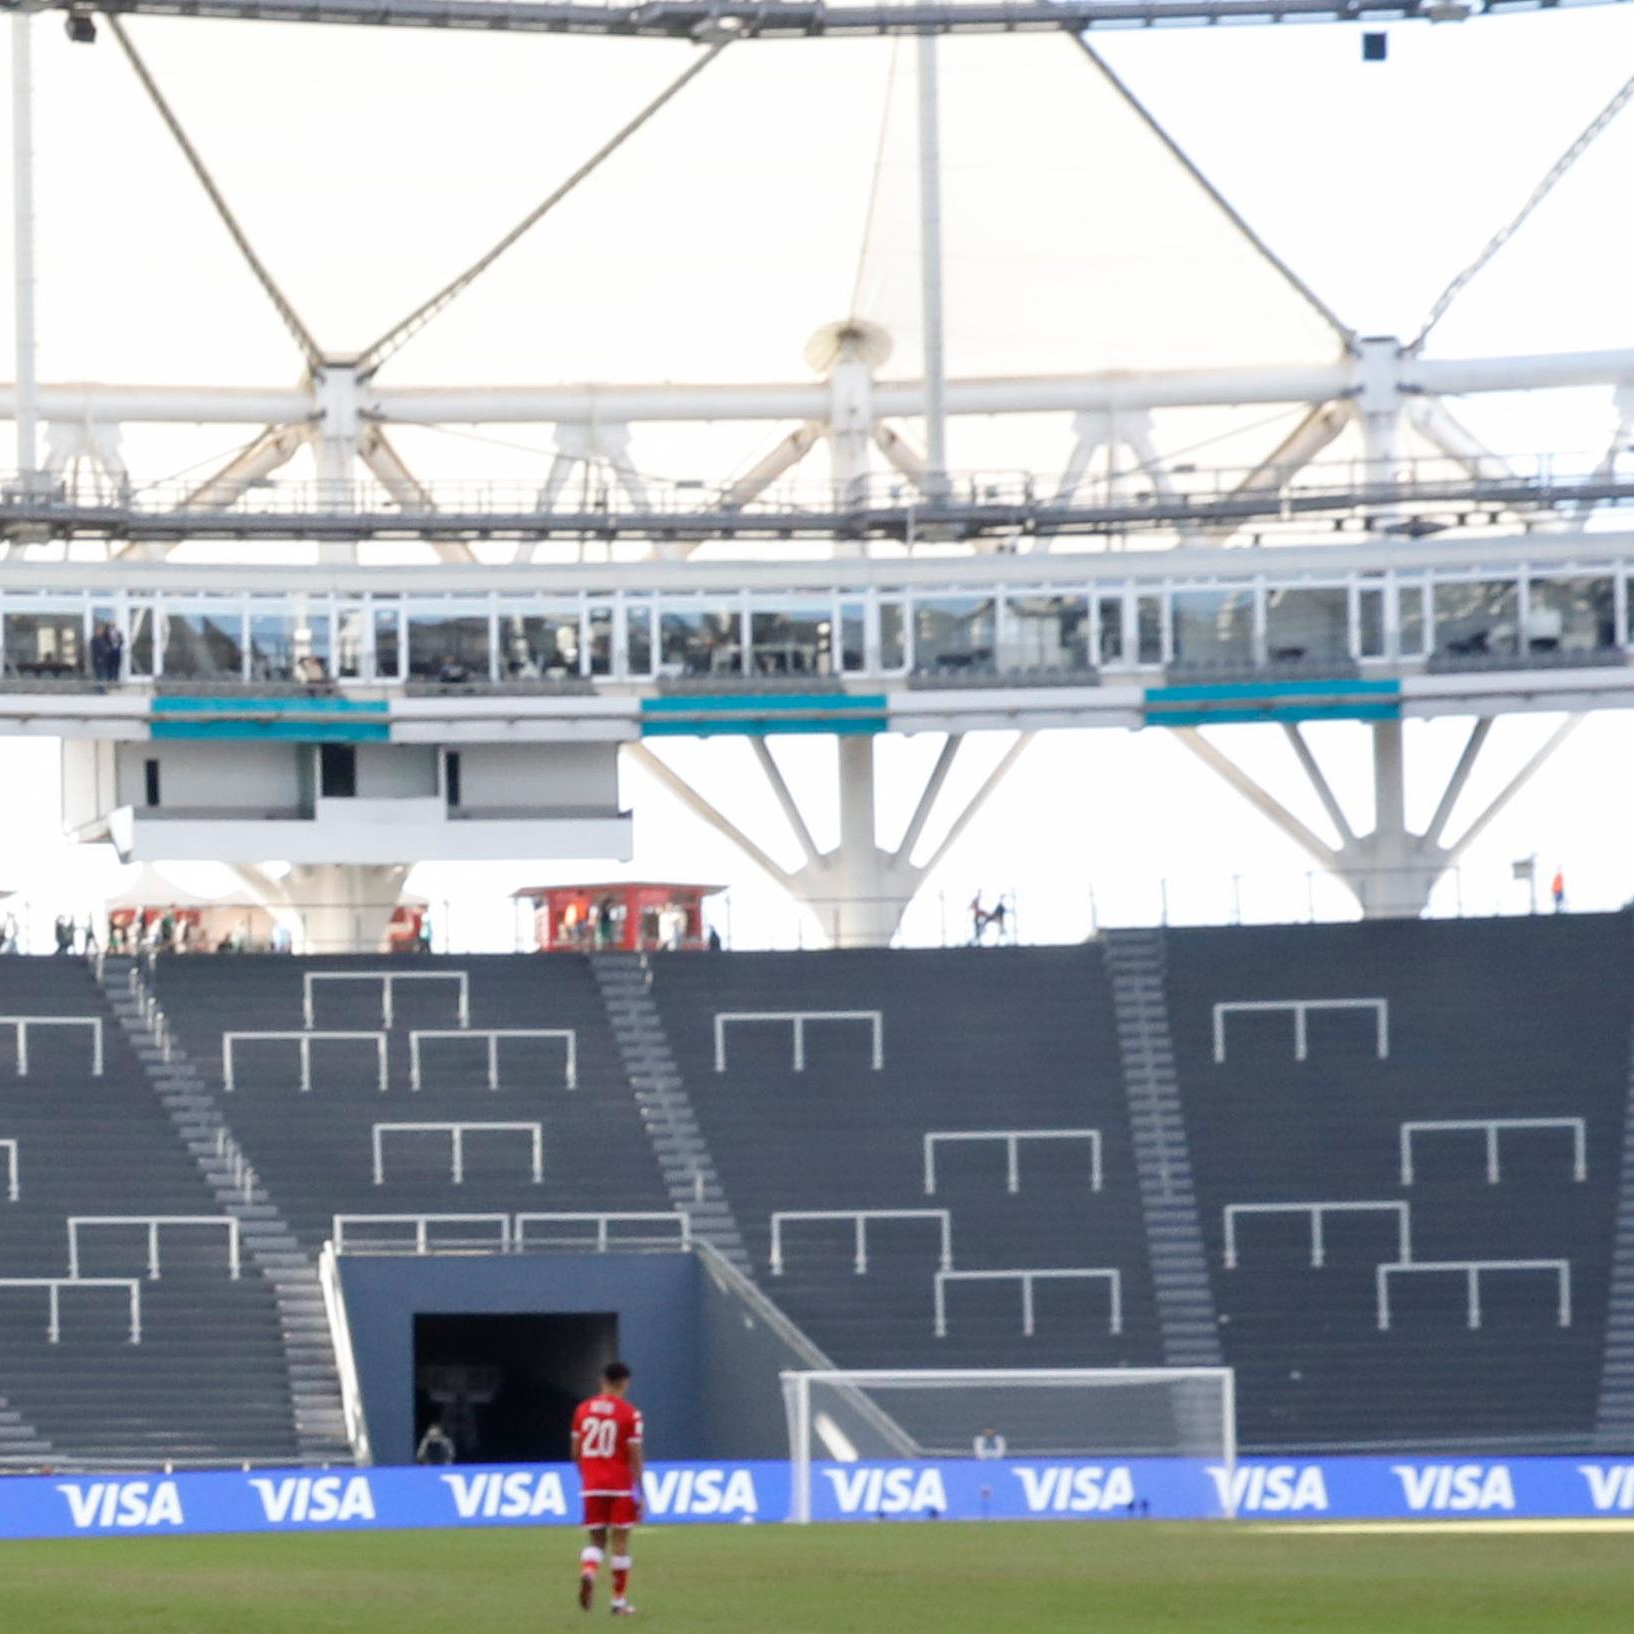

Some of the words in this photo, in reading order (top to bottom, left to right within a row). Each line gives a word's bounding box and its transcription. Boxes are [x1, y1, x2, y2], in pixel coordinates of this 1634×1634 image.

[580, 1416, 618, 1458] 20
[56, 1481, 184, 1529] VISA
[247, 1476, 375, 1522] VISA
[440, 1472, 568, 1519] VISA
[642, 1469, 759, 1515] VISA
[823, 1467, 948, 1513] VISA
[1012, 1466, 1134, 1512] VISA
[1204, 1465, 1329, 1511] VISA
[1391, 1465, 1516, 1511] VISA
